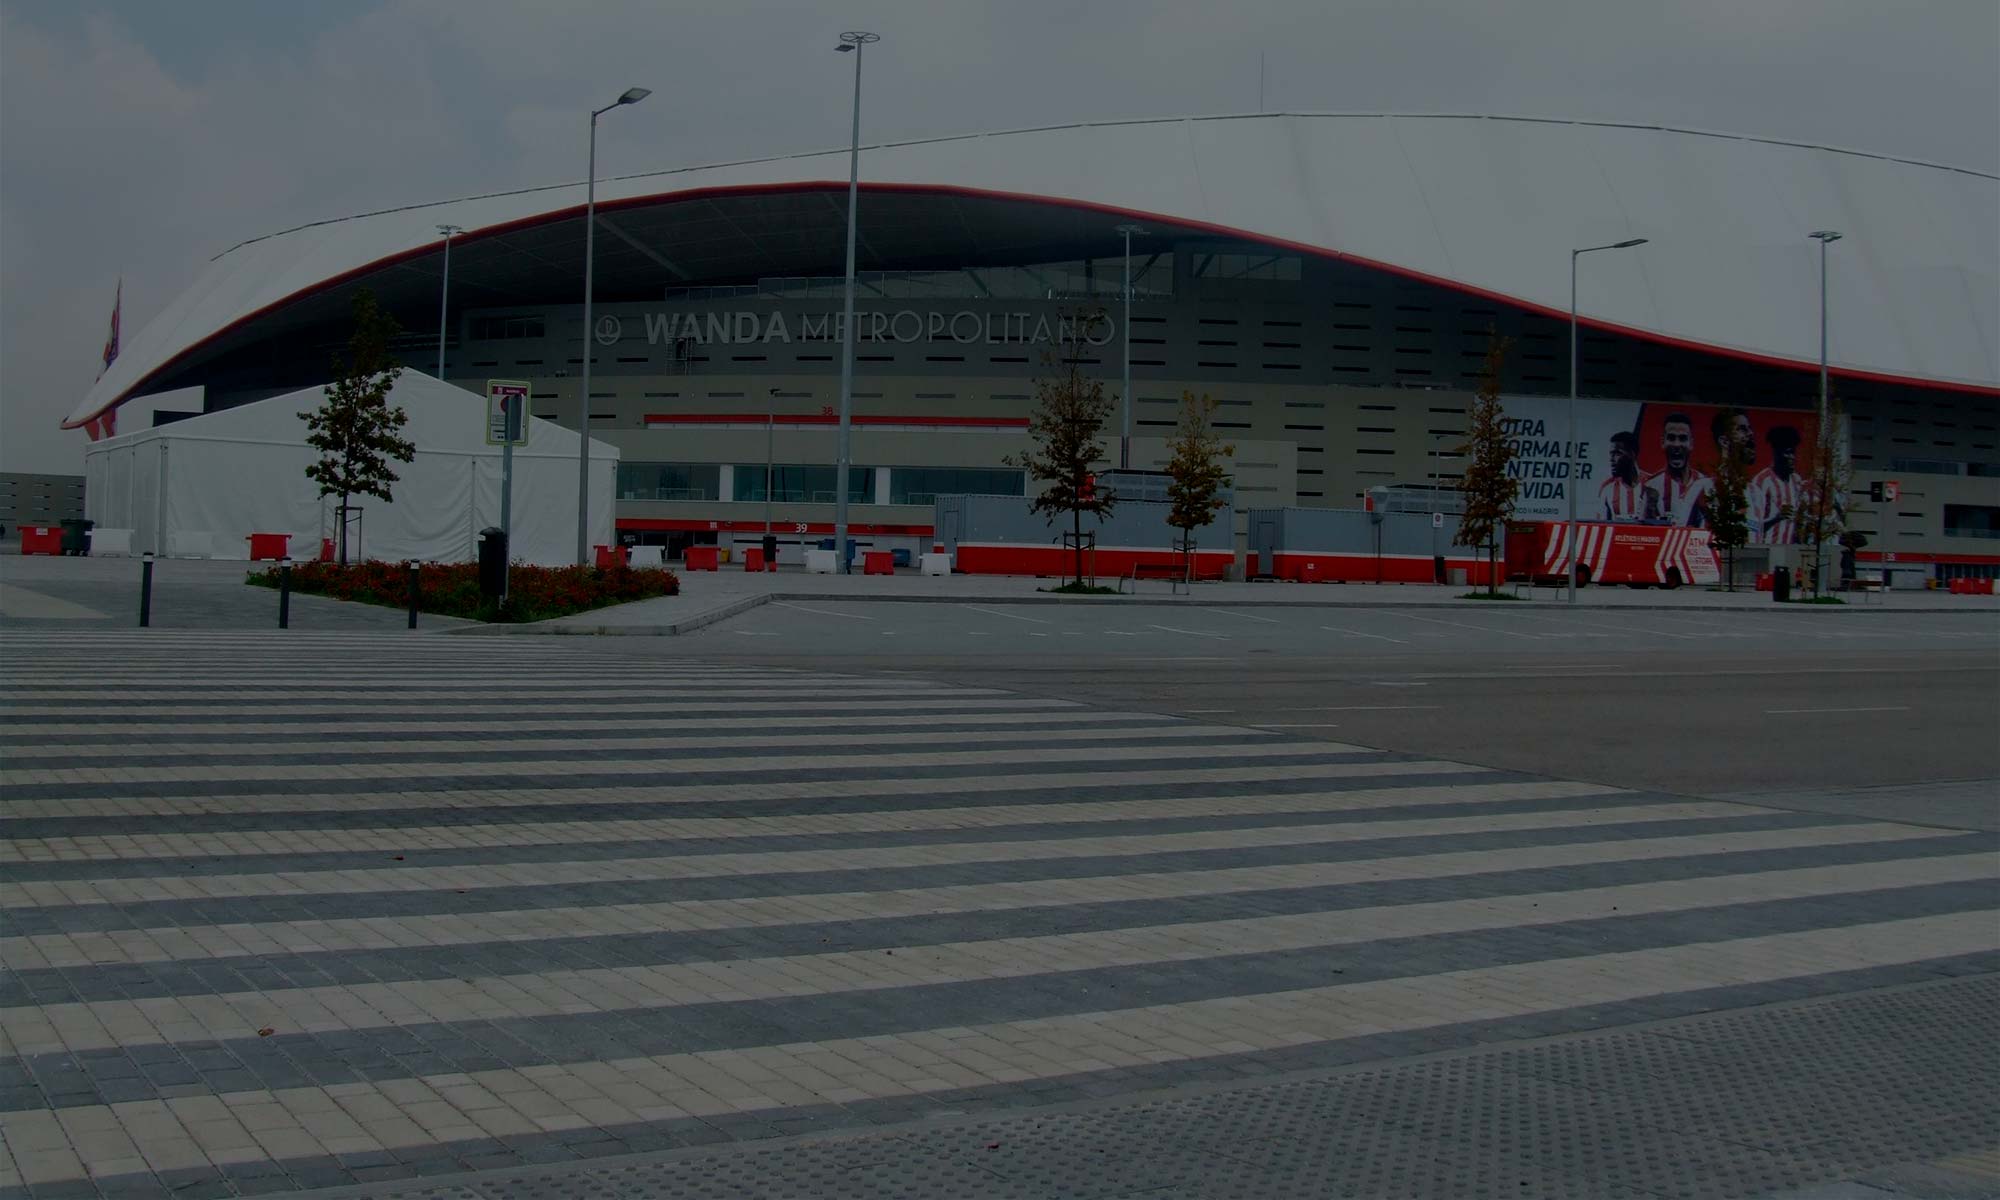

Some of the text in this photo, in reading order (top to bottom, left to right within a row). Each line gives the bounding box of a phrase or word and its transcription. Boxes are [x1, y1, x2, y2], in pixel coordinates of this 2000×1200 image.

[644, 310, 1117, 346] WANDA METROPOLITANO
[1499, 418, 1545, 437] OTRA
[1503, 440, 1561, 458] ORMA
[1506, 460, 1593, 480] NTENDER
[1523, 482, 1565, 499] VIDA
[795, 524, 808, 534] 39
